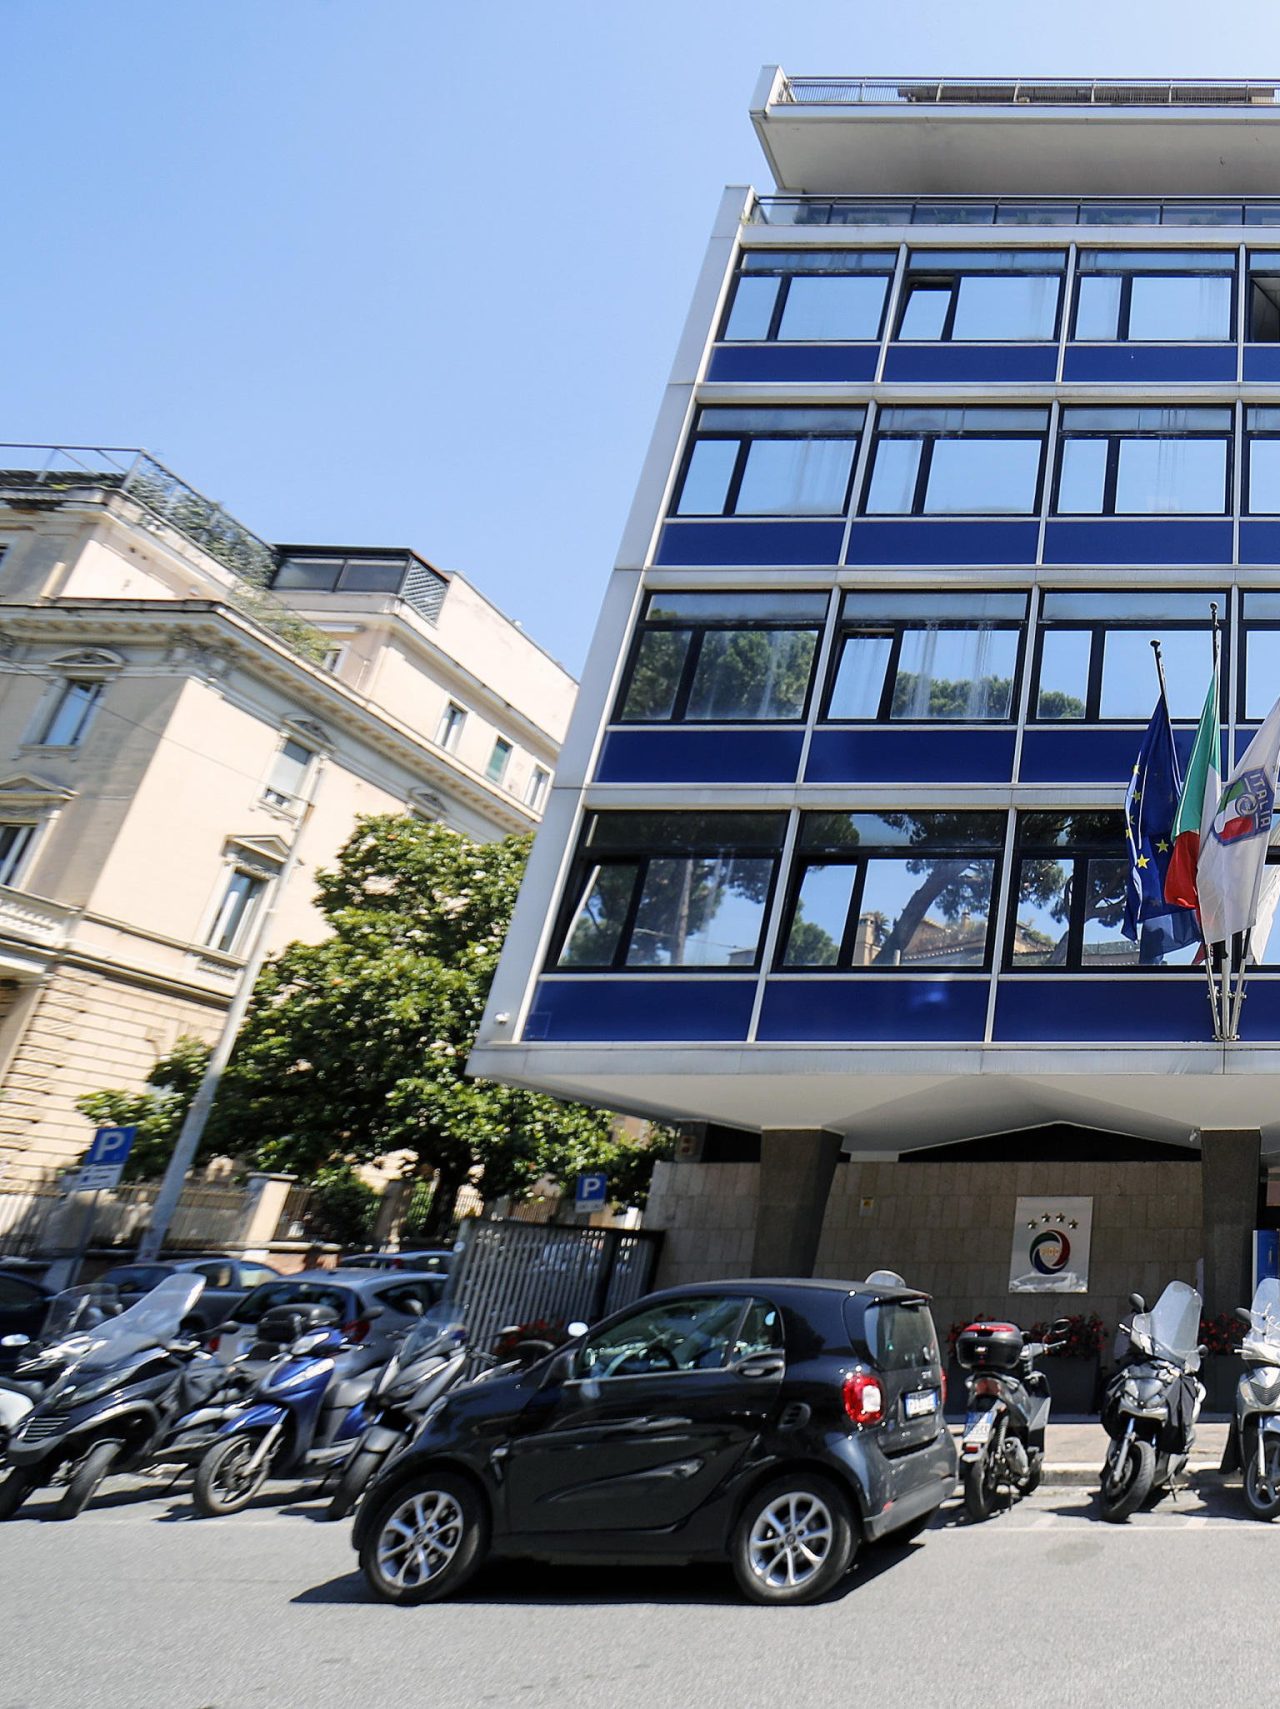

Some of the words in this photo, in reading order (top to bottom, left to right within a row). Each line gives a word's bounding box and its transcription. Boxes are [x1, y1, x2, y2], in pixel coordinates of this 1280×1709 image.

[1250, 774, 1271, 827] ITALIA
[94, 1131, 125, 1160] P
[582, 1178, 600, 1198] P
